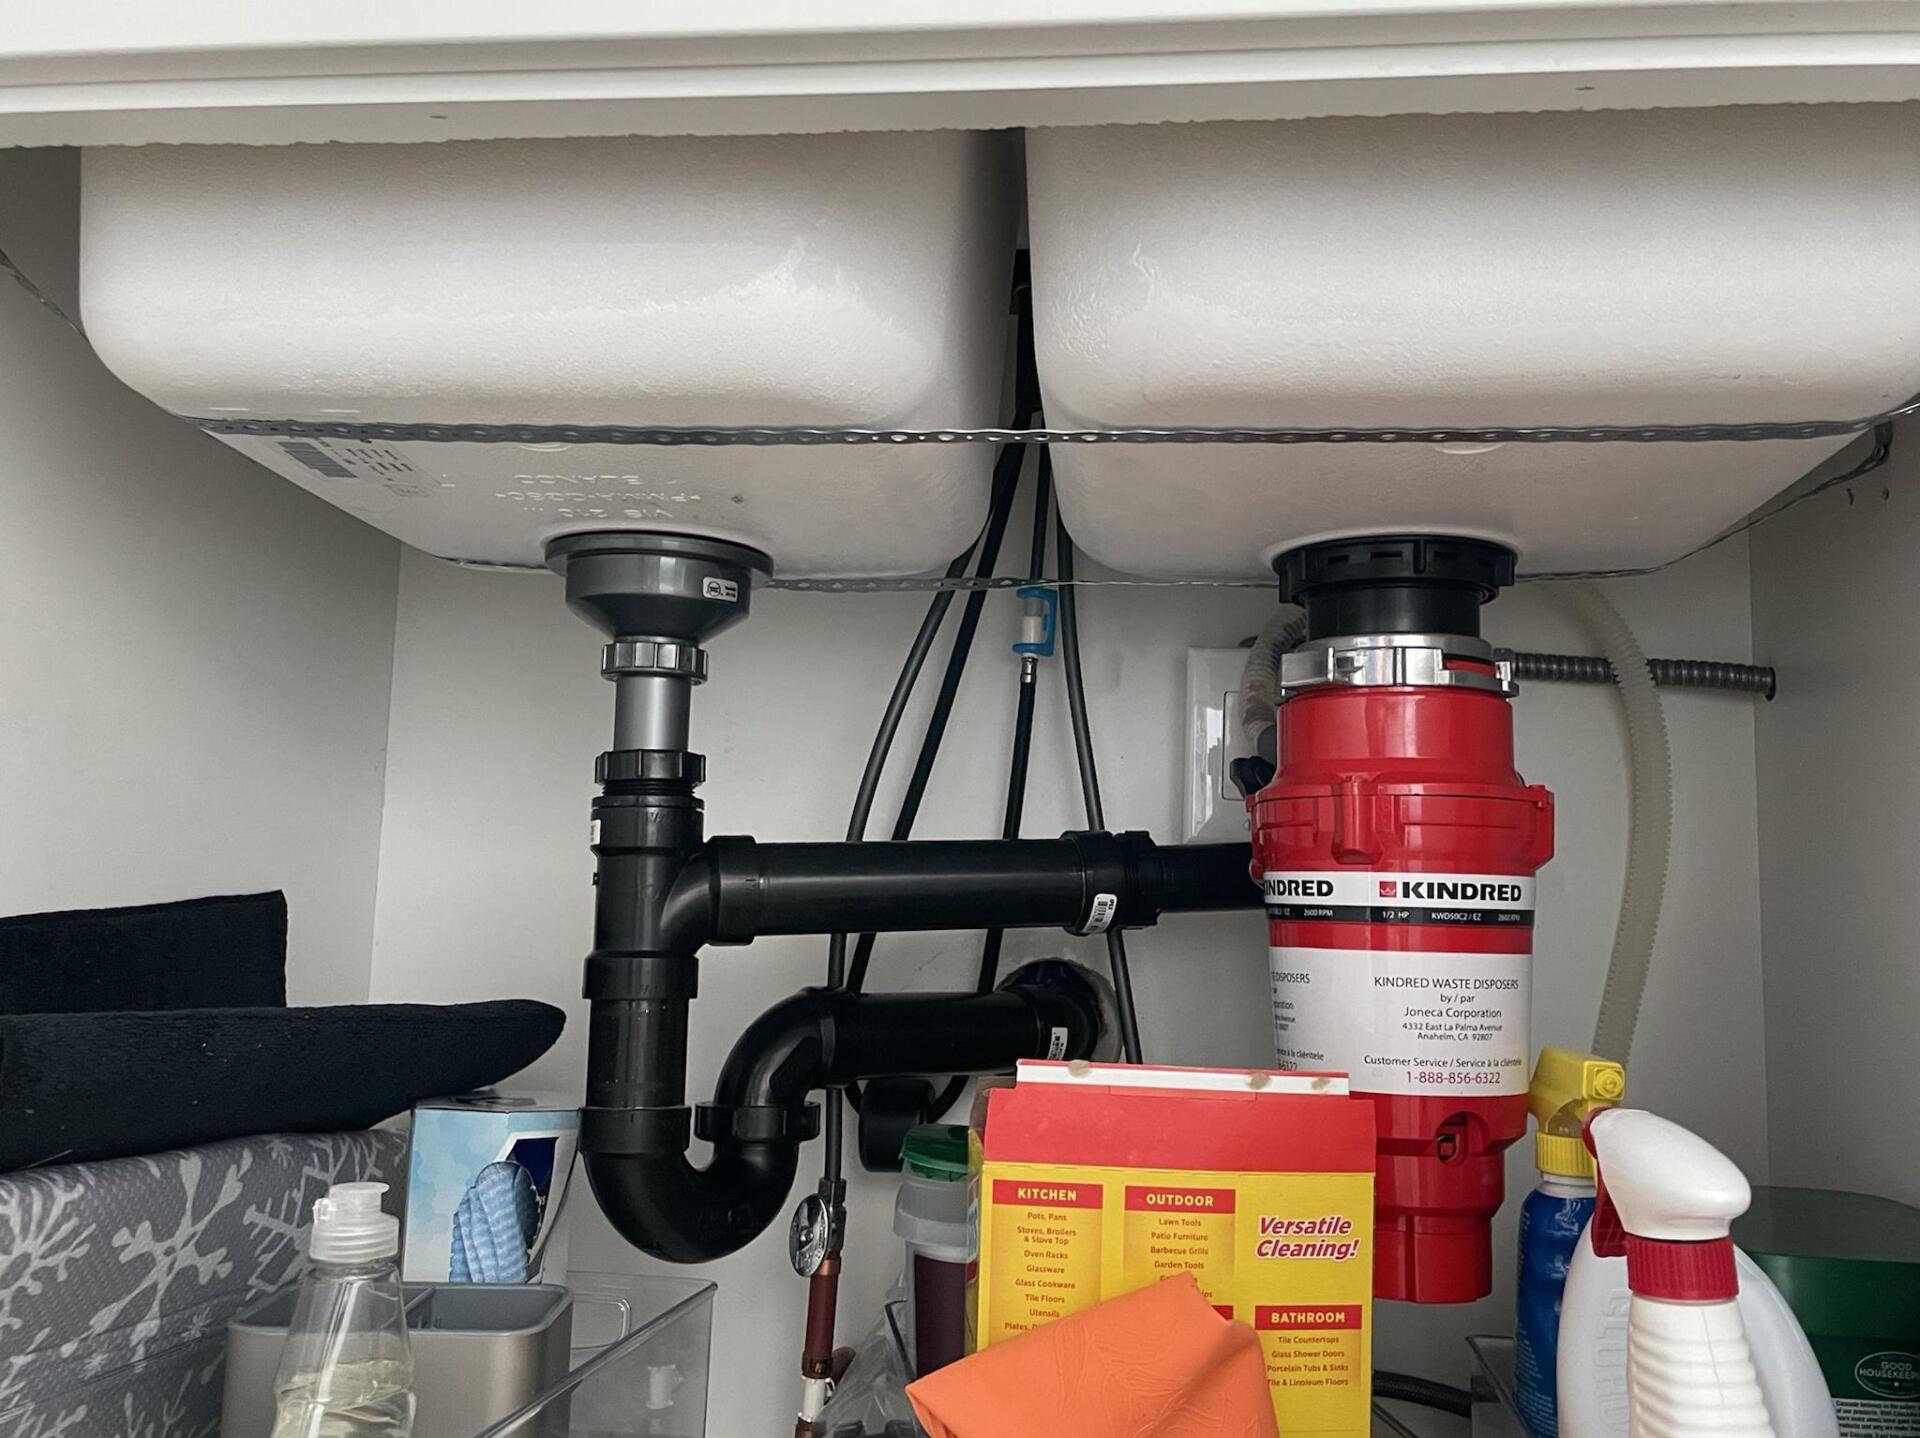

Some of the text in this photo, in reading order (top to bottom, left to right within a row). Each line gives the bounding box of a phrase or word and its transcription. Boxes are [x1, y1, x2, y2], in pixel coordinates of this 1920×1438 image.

[1264, 879, 1334, 897] INDRED
[1402, 881, 1522, 902] KINDRED
[1382, 910, 1395, 919] 1/2
[1397, 911, 1410, 919] HP
[1473, 912, 1482, 921] EZ
[1374, 976, 1519, 990] KINDRED WASTE DISPOSERS
[1440, 993, 1452, 1004] by
[1460, 994, 1475, 1003] par
[1404, 1007, 1502, 1019] Joneca Corporation
[1402, 1022, 1502, 1032] 4332 East La Palma Avenue
[1417, 1032, 1493, 1042] Anaheim, CA 92807
[1364, 1054, 1412, 1066] Customer
[1413, 1056, 1449, 1068] Service
[1456, 1058, 1486, 1068] Service
[1406, 1071, 1501, 1085] 1-888-856-6322
[1017, 1187, 1077, 1201] KITCHEN
[1146, 1193, 1214, 1207] OUTDOOR
[1027, 1212, 1067, 1221] Pots, Pans
[1158, 1218, 1202, 1227] Lawn Tools
[1259, 1215, 1353, 1236] Versatile
[1017, 1225, 1077, 1237] Stoves, Broilers
[1151, 1232, 1208, 1241] Patio Furniture
[1023, 1235, 1069, 1246] & Stove Top
[1023, 1249, 1069, 1260] Oven Racks
[1150, 1246, 1209, 1256] Barbecue Grills
[1256, 1238, 1360, 1262] Cleaning!
[1026, 1264, 1066, 1274] Glassware
[1154, 1260, 1204, 1270] Garden Tools
[1015, 1278, 1076, 1289] Glass Cookware
[1025, 1293, 1065, 1304] Tile Floors
[1029, 1308, 1060, 1318] Utensils
[1270, 1312, 1345, 1324] BATHROOM
[1004, 1322, 1031, 1332] Plates,
[1277, 1335, 1340, 1345] Tile Countertops
[1271, 1350, 1345, 1359] Glass Shower Doors
[1267, 1363, 1349, 1373] Porcelain Tubs & Sinks
[1880, 1361, 1913, 1371] GOOD
[1859, 1367, 1920, 1380] HOUSEKEEP
[1281, 1379, 1288, 1387] &
[1289, 1378, 1324, 1387] Linoleum
[1325, 1377, 1349, 1387] Floors
